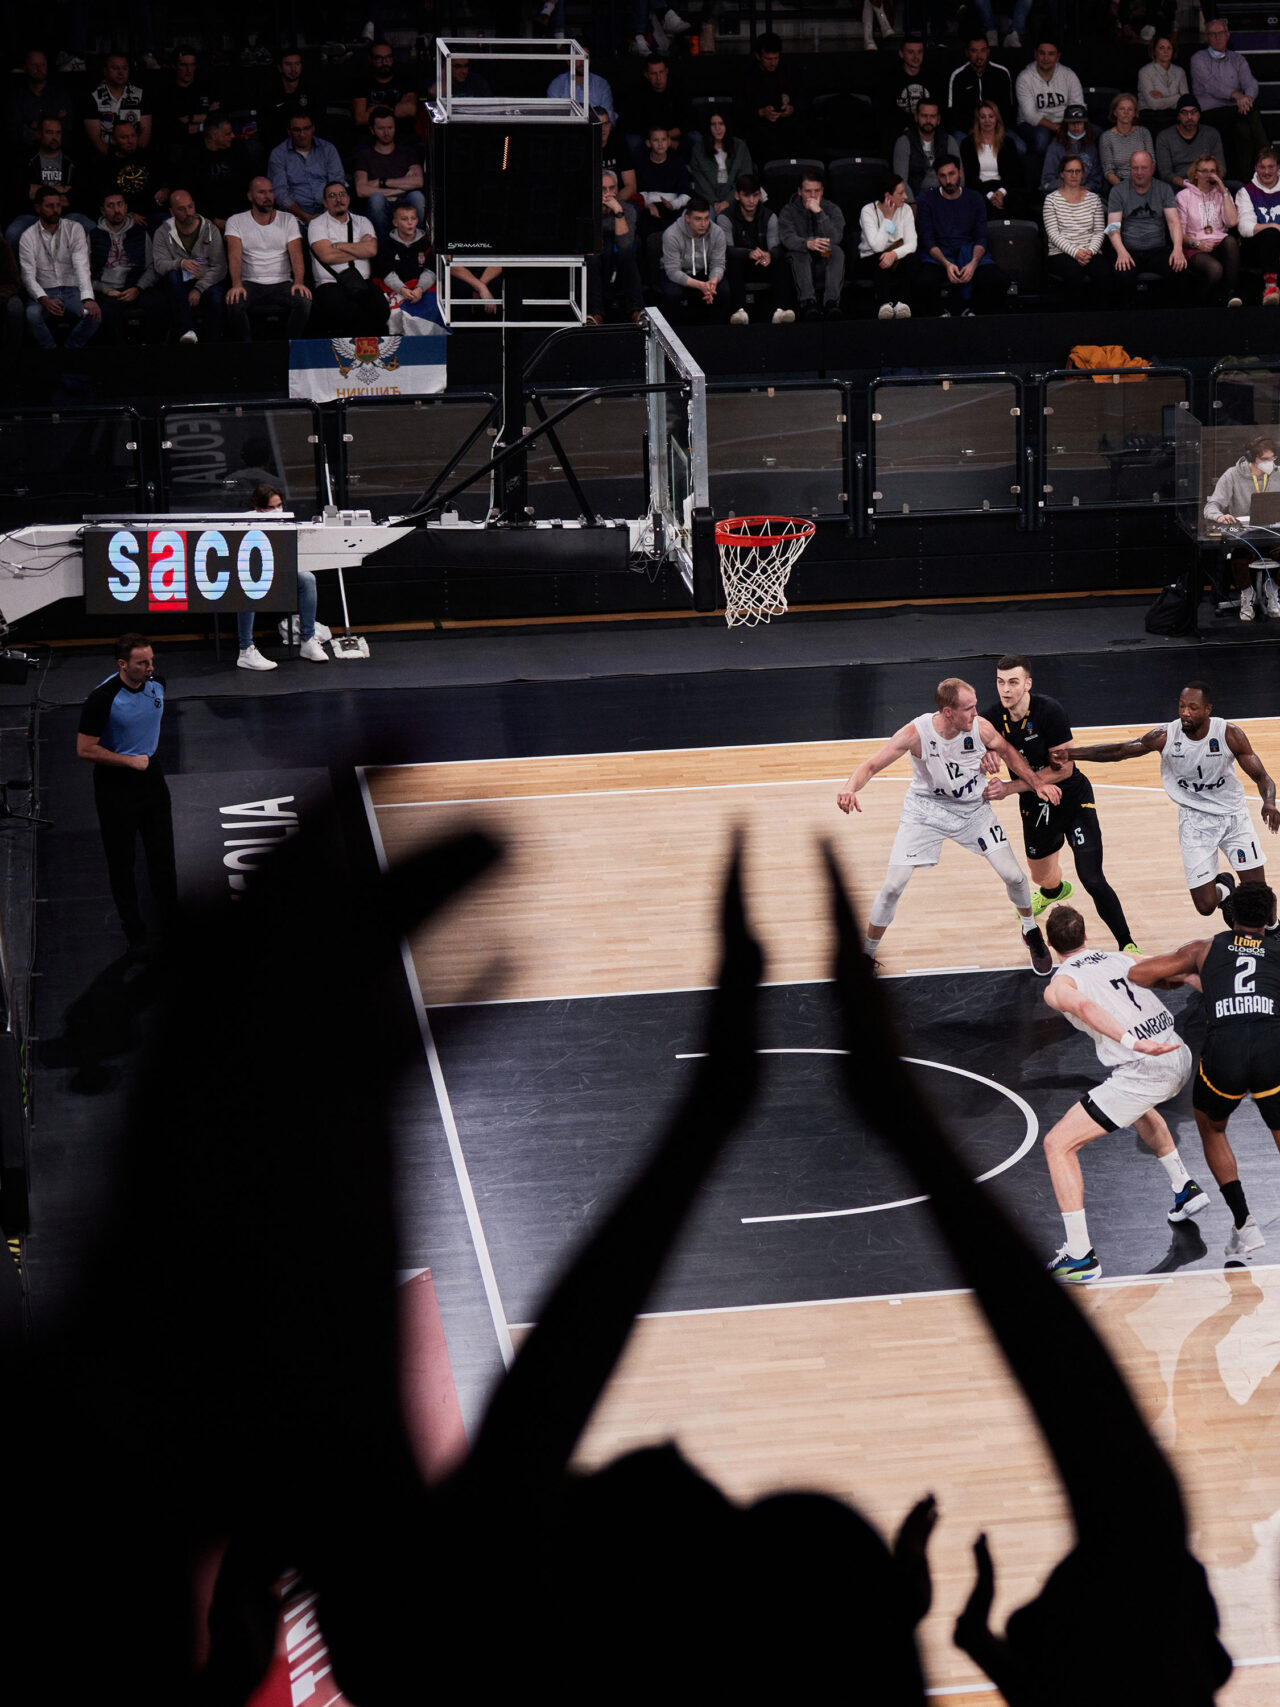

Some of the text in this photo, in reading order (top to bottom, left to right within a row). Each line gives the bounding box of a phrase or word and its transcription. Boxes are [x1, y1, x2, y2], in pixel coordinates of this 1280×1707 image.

[1036, 92, 1066, 109] GAP
[447, 242, 493, 250] STRAMATEL
[108, 529, 274, 602] saco
[945, 762, 964, 780] 12
[1196, 765, 1203, 779] 1
[989, 825, 1007, 843] 12
[1251, 841, 1258, 860] 1
[1233, 935, 1263, 948] LEDAY
[1234, 956, 1257, 994] 2
[1109, 977, 1142, 1012] 7
[1215, 995, 1275, 1018] BELGRADE
[1128, 1010, 1174, 1040] AMBURG
